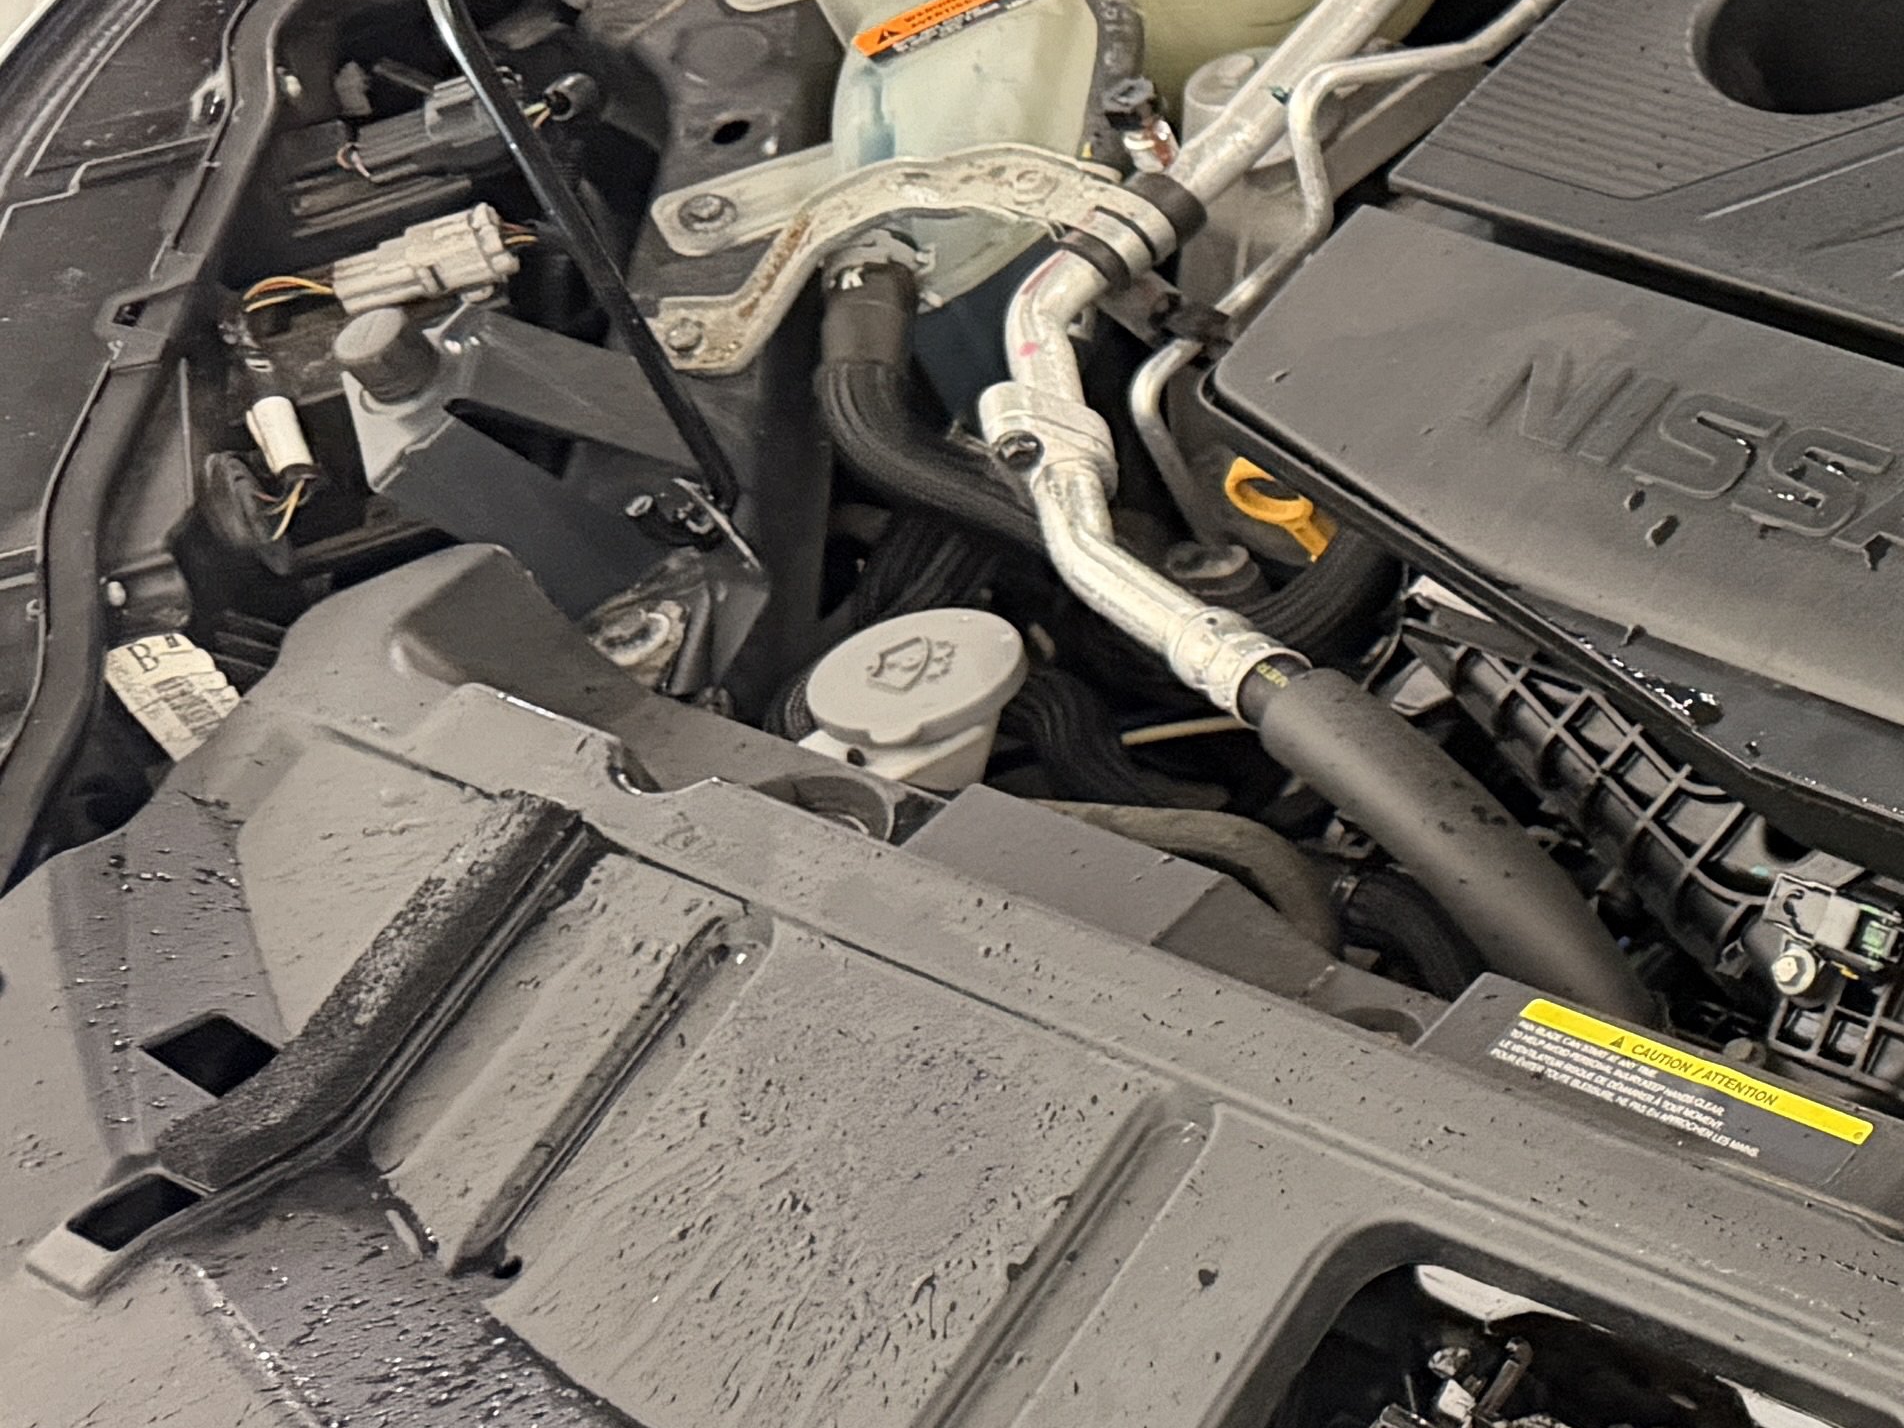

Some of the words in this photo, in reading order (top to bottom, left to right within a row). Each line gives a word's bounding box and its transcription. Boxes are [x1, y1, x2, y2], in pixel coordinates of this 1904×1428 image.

[127, 643, 160, 673] B
[1520, 1032, 1547, 1047] HELP
[1541, 1040, 1572, 1057] AVOID
[1566, 1050, 1616, 1074] PERSONAL
[1662, 1086, 1695, 1105] HANDS
[1533, 1026, 1564, 1042] BLADE
[1560, 1036, 1583, 1049] CAN
[1615, 1057, 1638, 1071] ANY
[1559, 1061, 1596, 1080] RISQUE
[1631, 1043, 1693, 1074] CAUTION
[1701, 1070, 1779, 1106] ATTENTION
[1488, 1045, 1519, 1062] POUR
[1541, 1066, 1573, 1084] TOUTE
[1624, 1099, 1646, 1114] PAS
[1653, 1111, 1714, 1141] APPROCHER
[1708, 1132, 1732, 1148] LES
